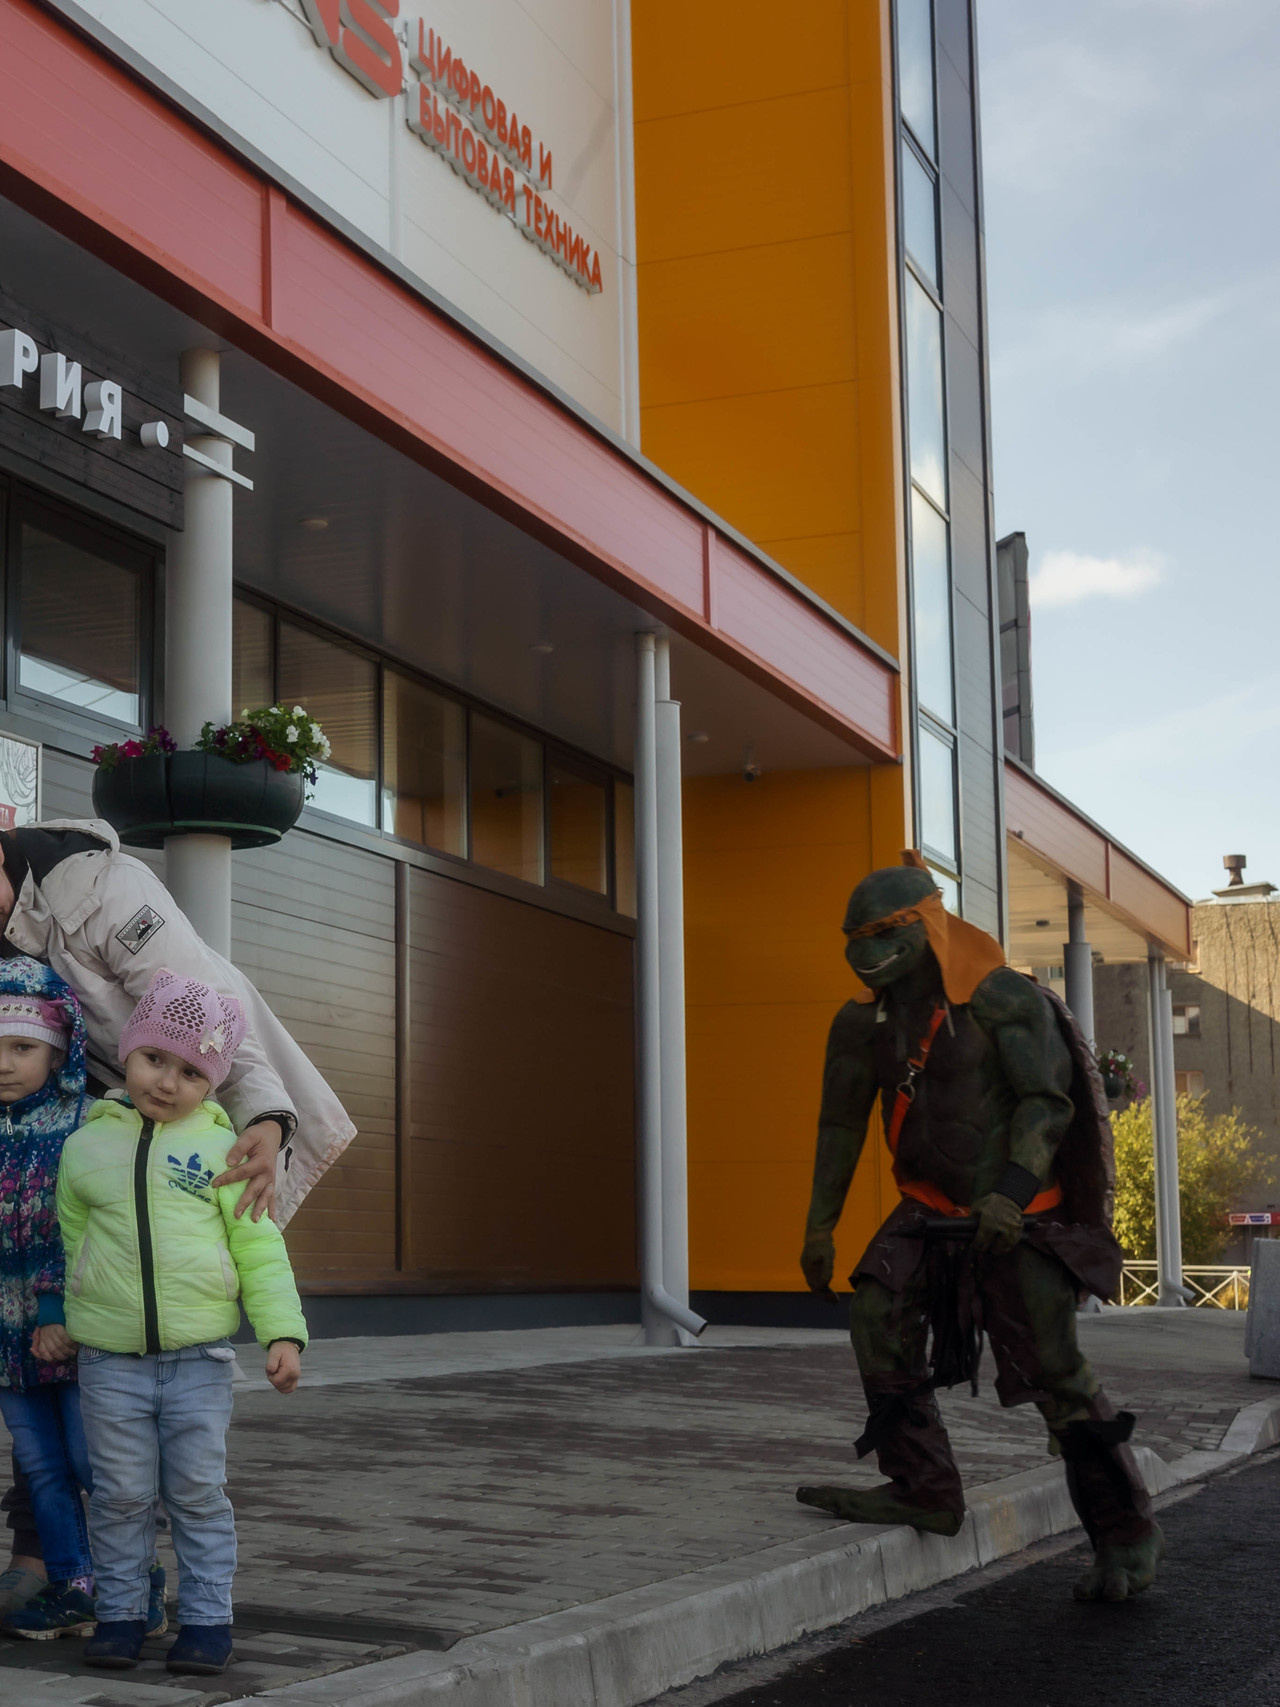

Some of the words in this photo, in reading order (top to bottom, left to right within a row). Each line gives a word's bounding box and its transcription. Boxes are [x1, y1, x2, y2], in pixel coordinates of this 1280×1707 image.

[418, 17, 532, 170] ЦИФРОВАЯ
[538, 141, 553, 191] И
[419, 81, 516, 213] БЫТОВАЯ
[522, 183, 603, 293] ТЕХНИКА
